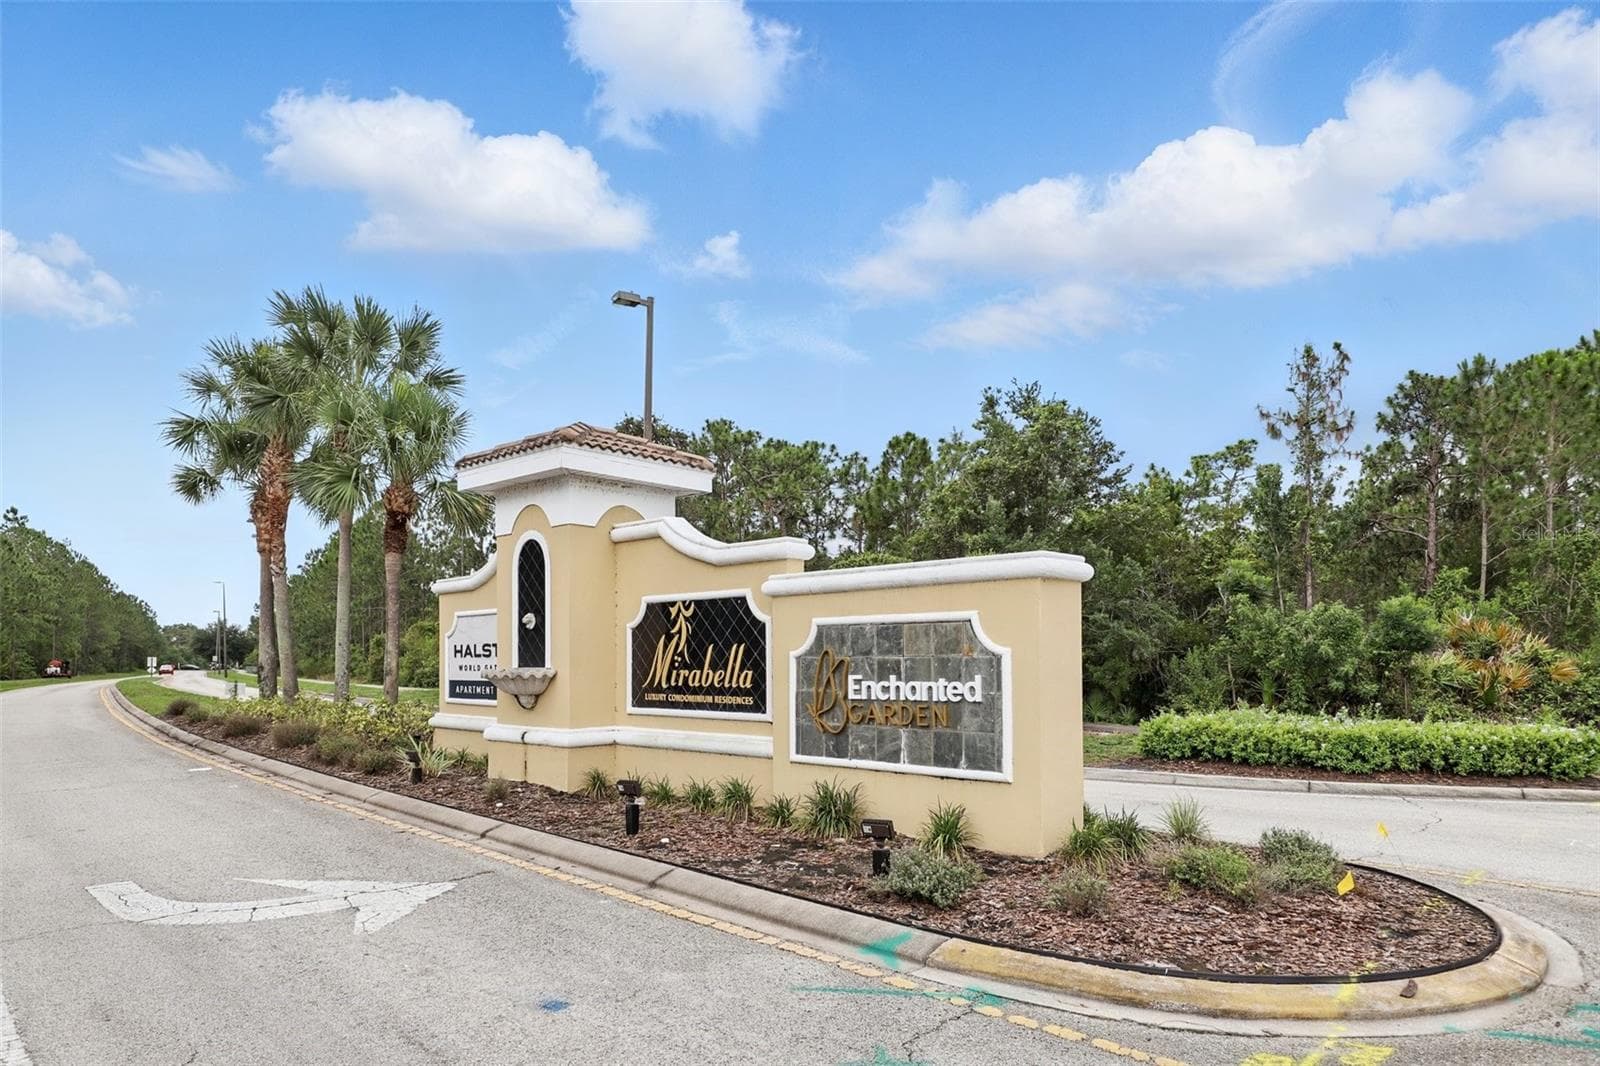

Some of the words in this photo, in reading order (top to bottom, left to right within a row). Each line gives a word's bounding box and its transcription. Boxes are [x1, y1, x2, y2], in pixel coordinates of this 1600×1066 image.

[642, 634, 753, 688] Mirabella
[645, 693, 666, 701] LUXURY
[667, 693, 713, 703] CONDOMINIUM
[714, 695, 754, 705] RESIDENCES
[847, 674, 982, 702] Enchanted
[850, 703, 949, 727] GARDEN
